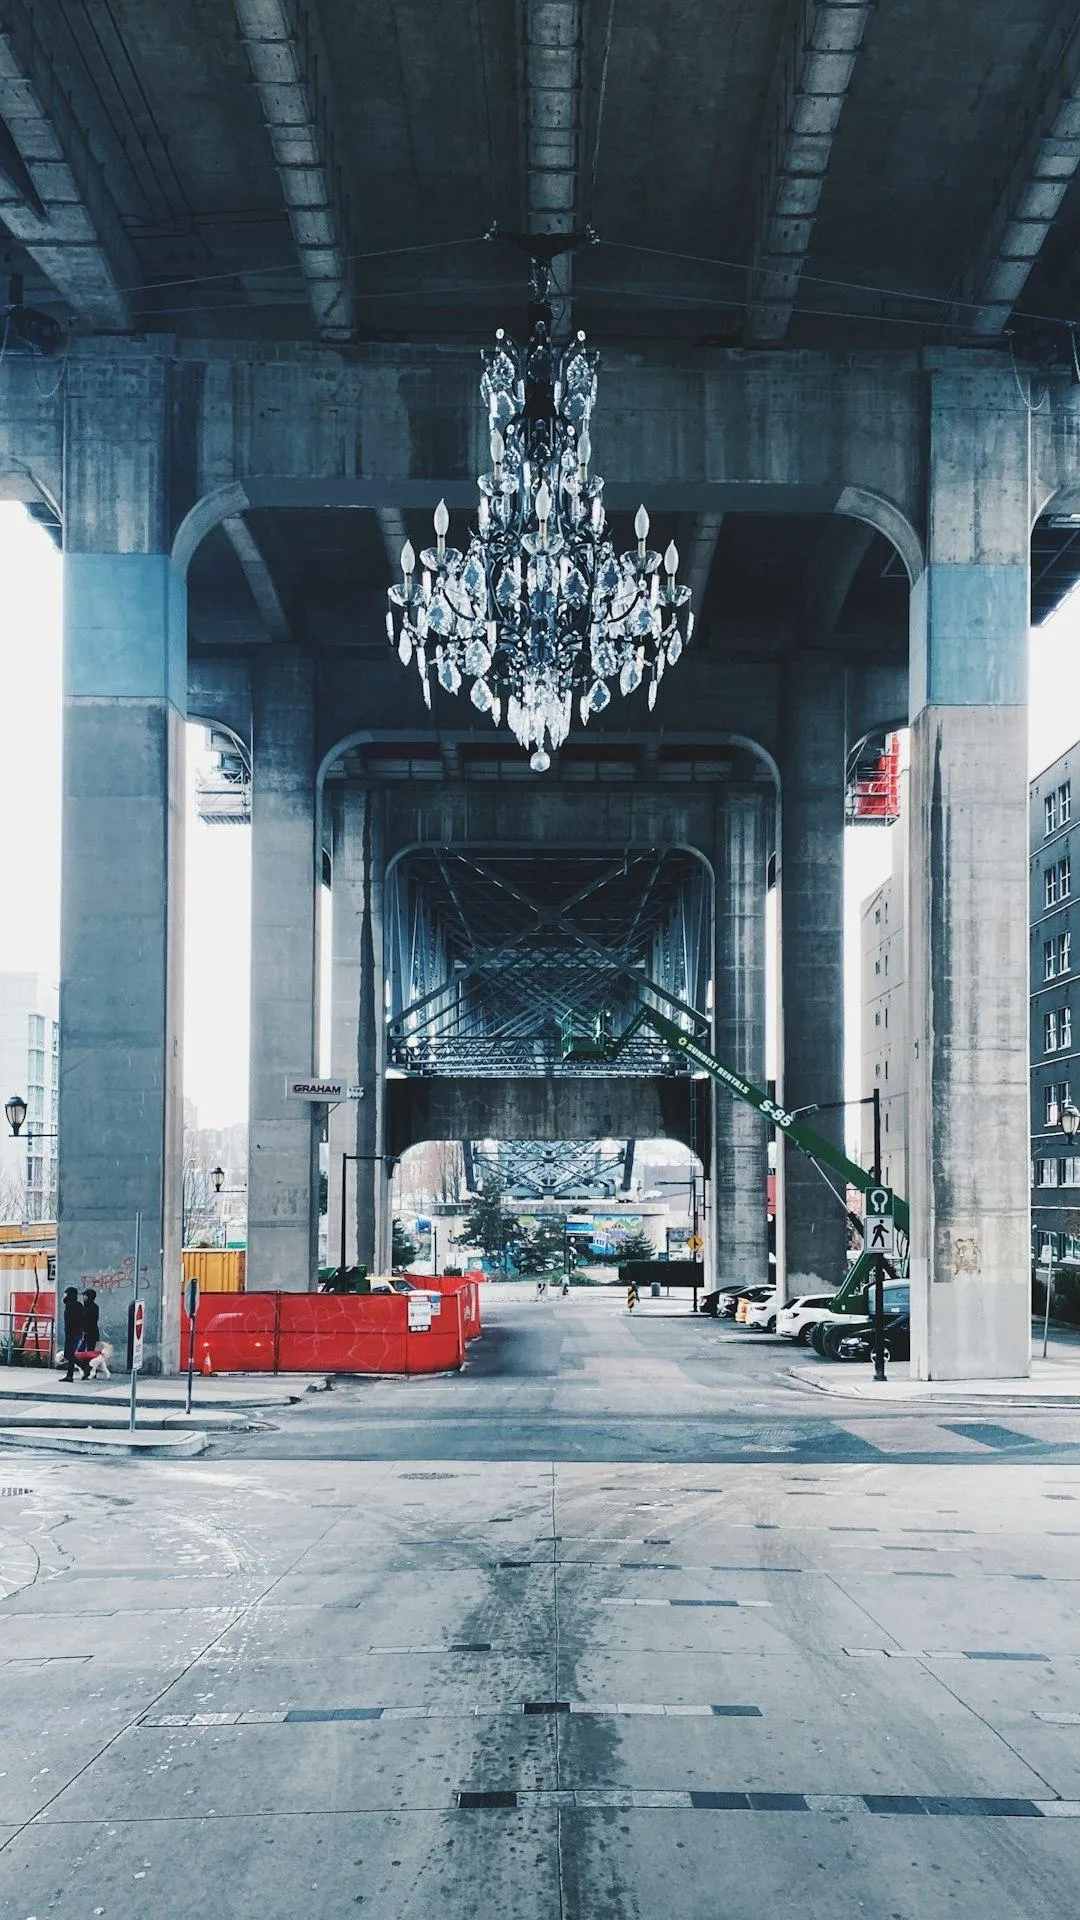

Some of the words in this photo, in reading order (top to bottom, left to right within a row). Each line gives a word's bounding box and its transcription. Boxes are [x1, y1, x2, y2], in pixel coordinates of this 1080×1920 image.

[686, 1043, 718, 1070] SUNBELT
[716, 1066, 750, 1094] RENTALS
[293, 1084, 341, 1094] GRAHAM
[759, 1100, 793, 1127] S-85
